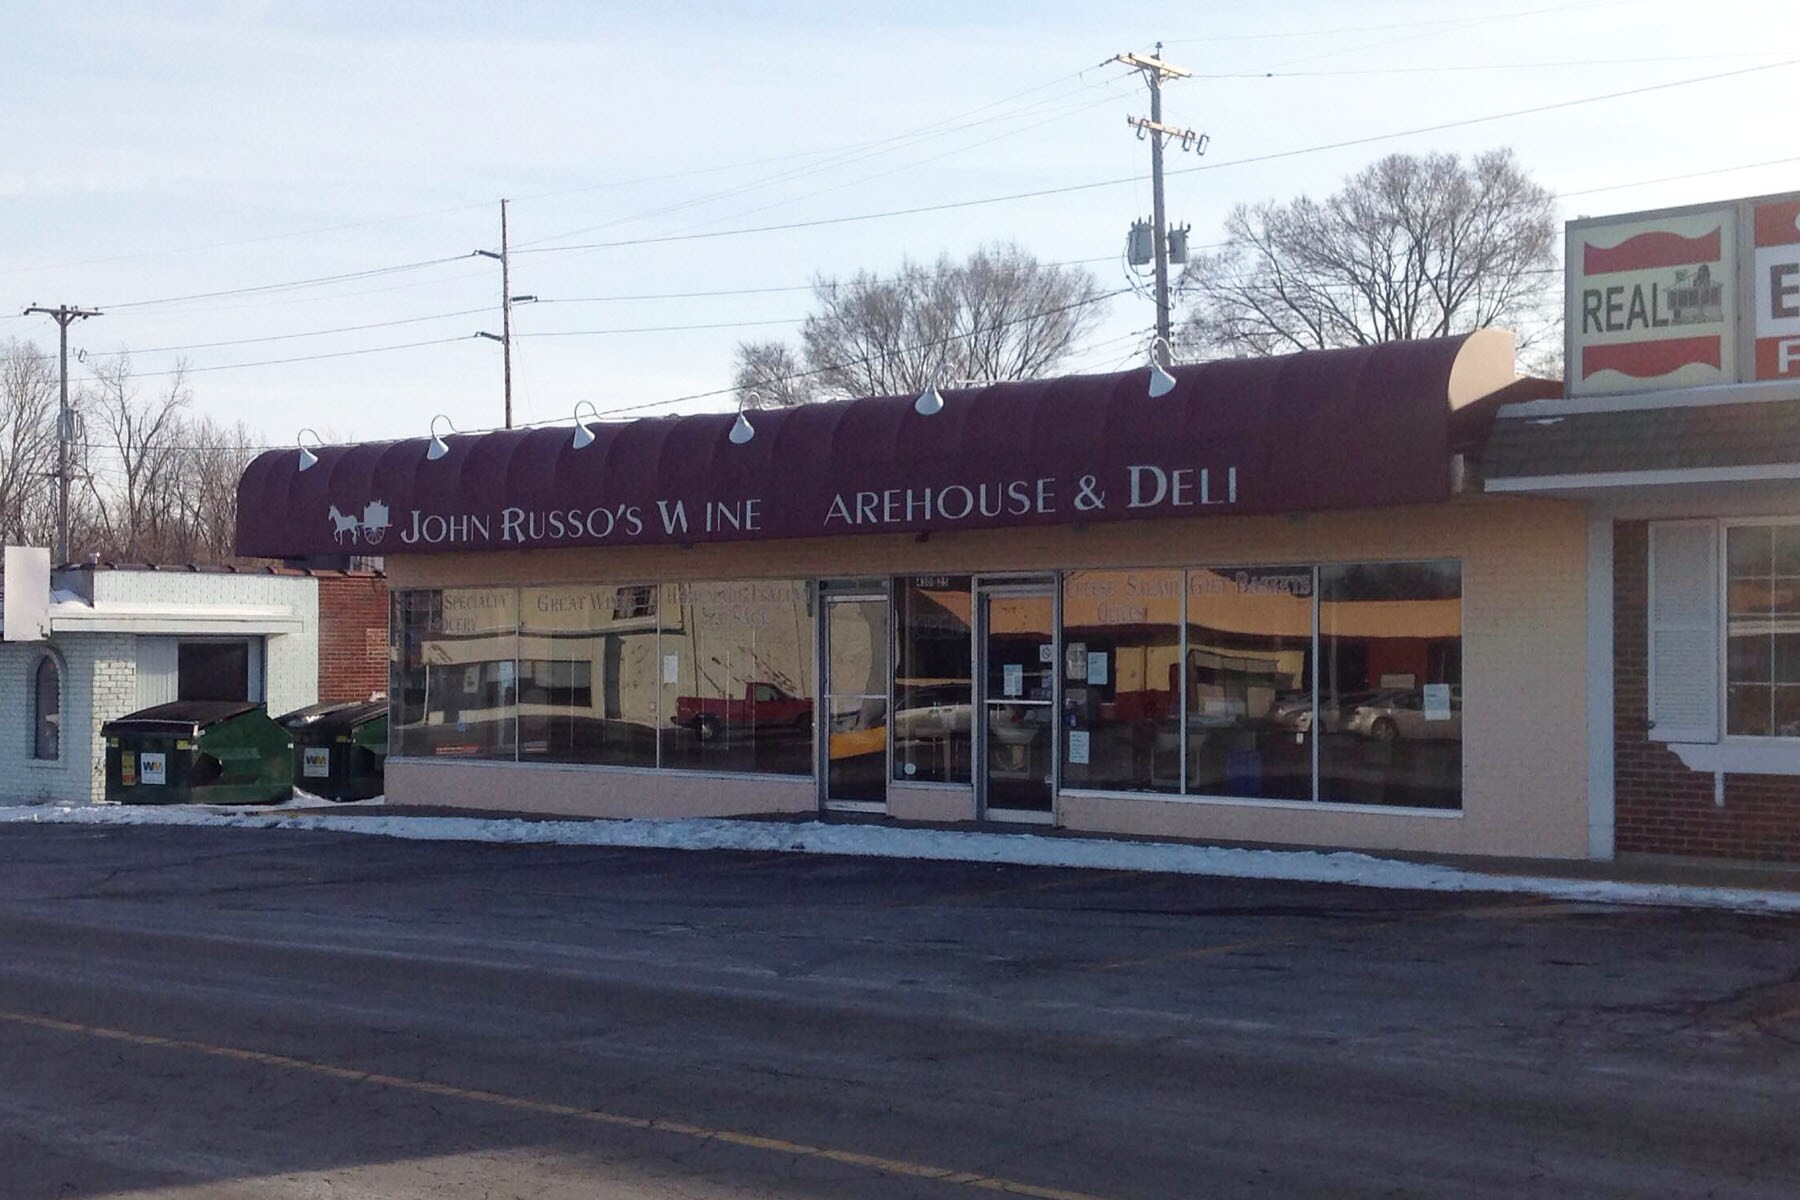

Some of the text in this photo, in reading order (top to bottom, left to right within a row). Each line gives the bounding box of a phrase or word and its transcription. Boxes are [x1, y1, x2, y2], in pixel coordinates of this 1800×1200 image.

[1582, 282, 1669, 334] REAL
[401, 510, 490, 543] JOHN
[501, 503, 644, 543] RUSSO'S
[823, 477, 1056, 526] AREHOUSE
[1073, 474, 1106, 511] &
[1126, 465, 1237, 508] DELI
[537, 592, 586, 612] GREAT
